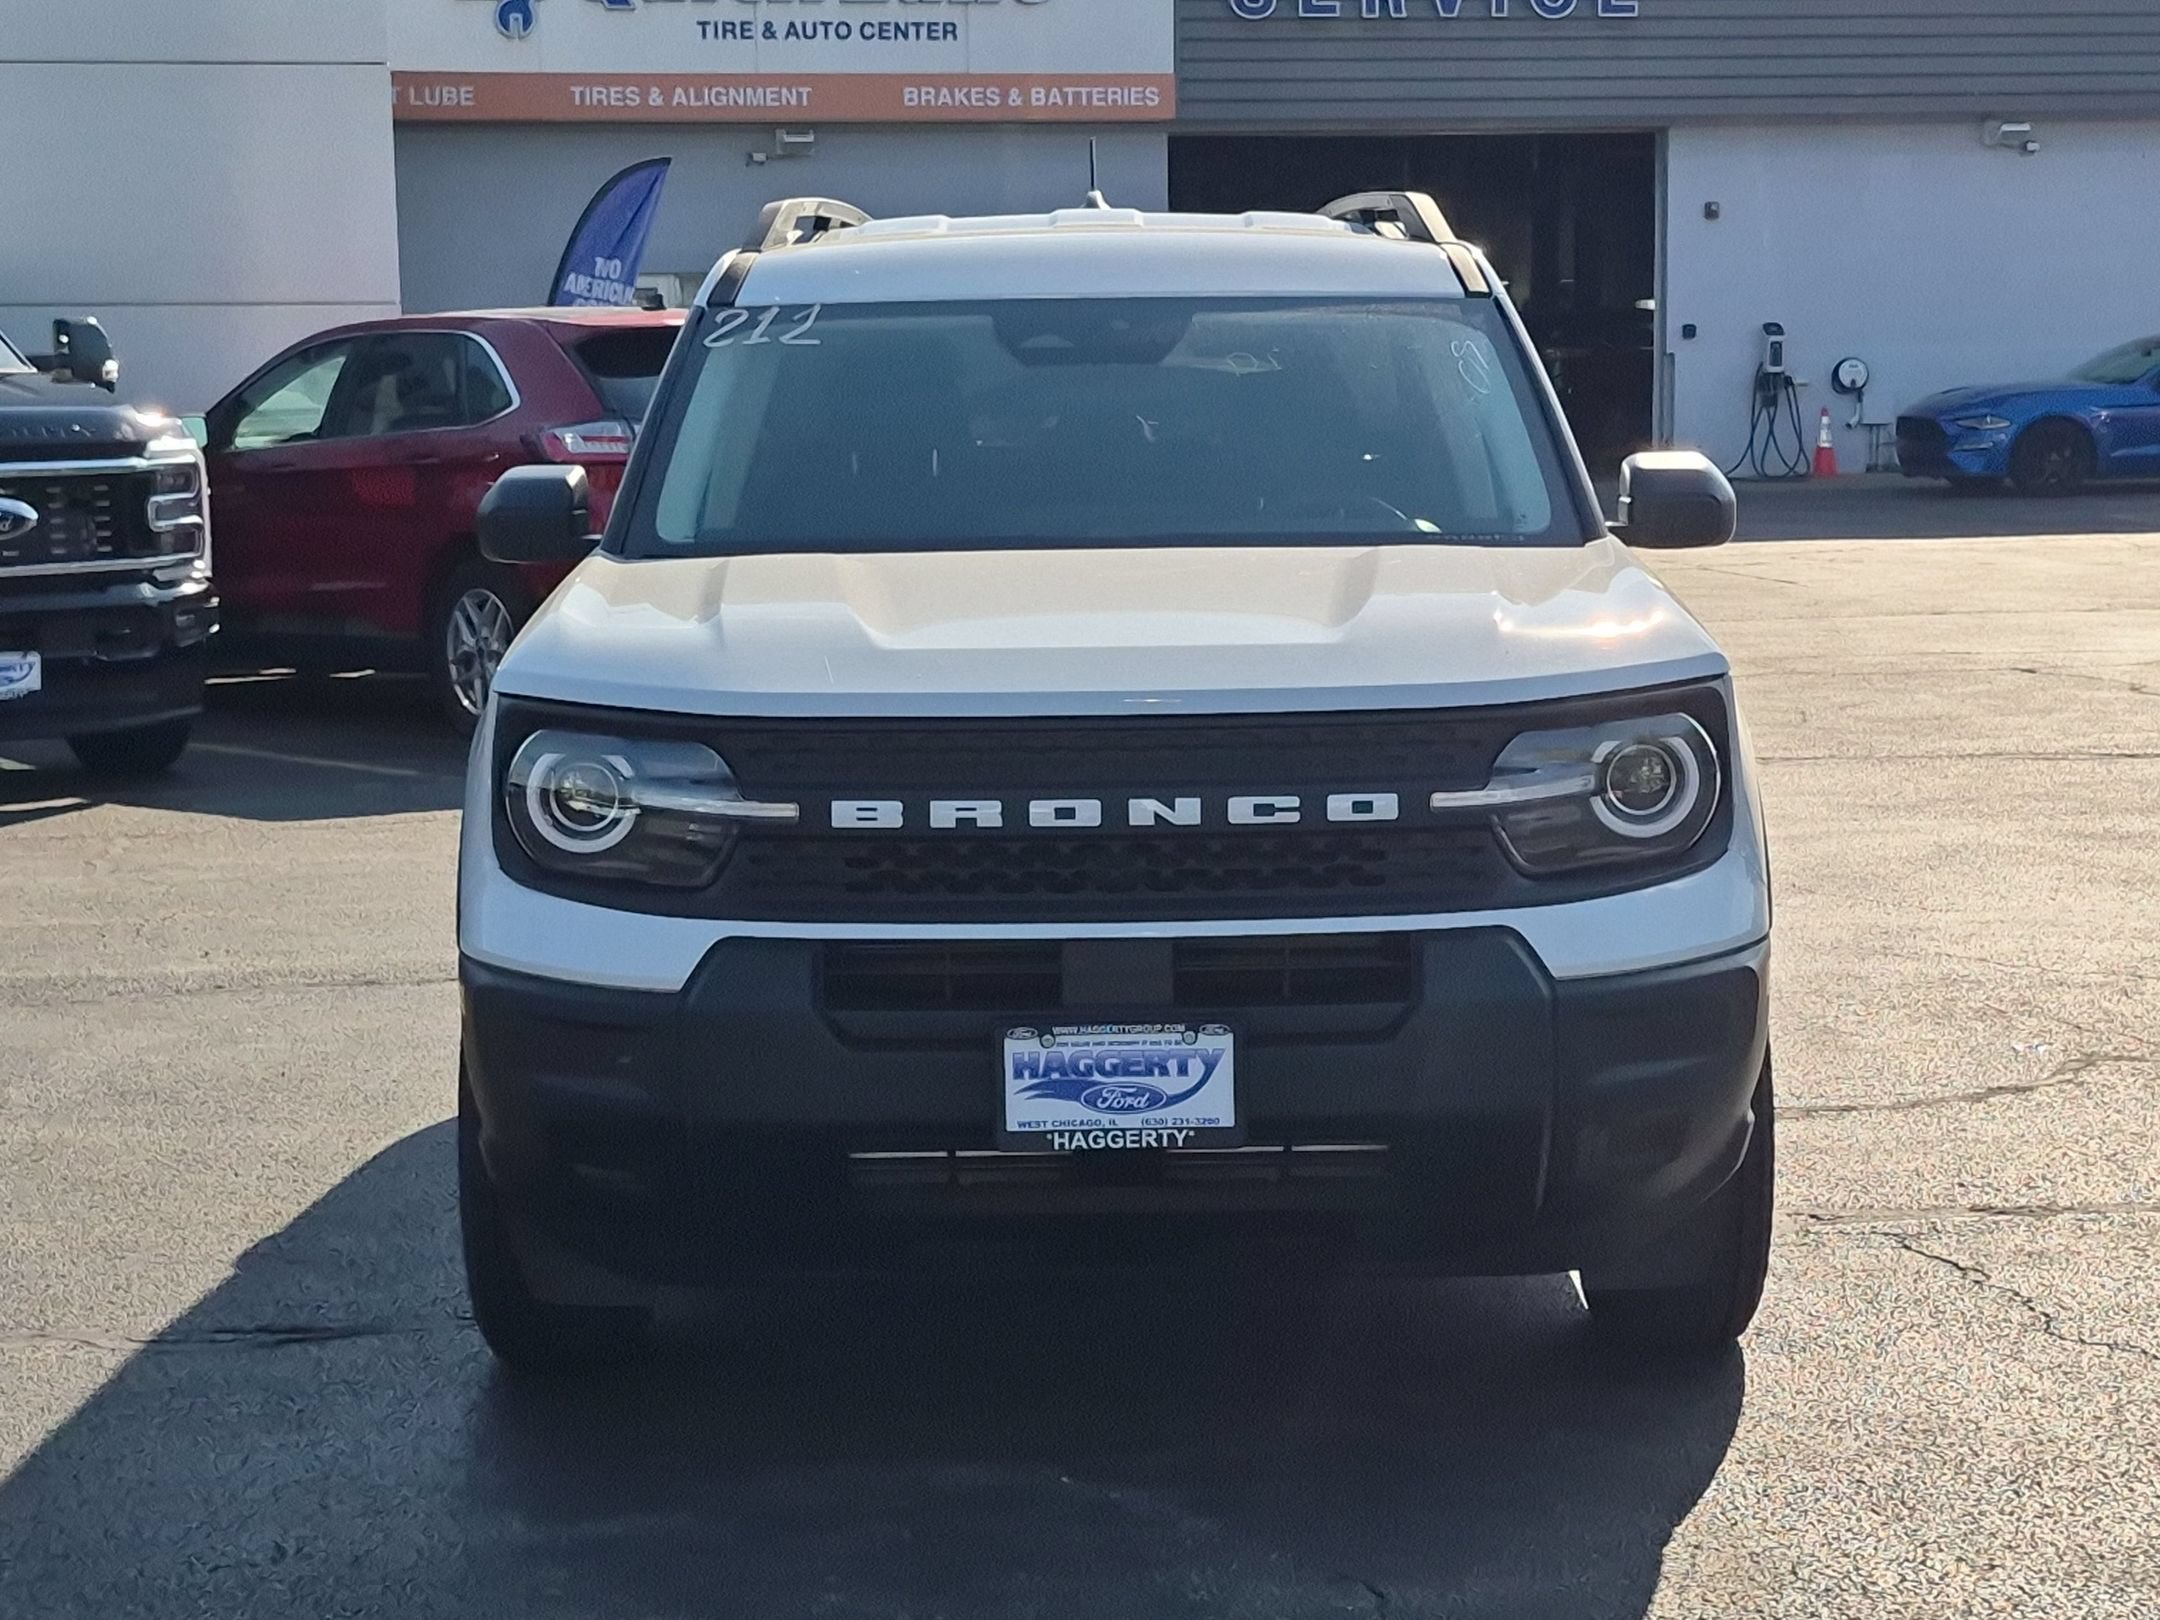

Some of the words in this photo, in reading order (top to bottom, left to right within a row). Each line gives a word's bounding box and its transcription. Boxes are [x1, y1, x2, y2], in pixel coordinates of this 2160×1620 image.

[696, 21, 754, 40] TIRE
[762, 20, 777, 40] &
[785, 21, 852, 40] AUTO
[859, 21, 958, 41] CENTER
[409, 86, 475, 106] LUBE
[570, 86, 641, 107] TIRES
[648, 86, 664, 106] &
[672, 87, 812, 107] ALIGNMENT
[903, 87, 1001, 107] BRAKES
[1008, 88, 1023, 106] &
[1031, 87, 1160, 107] BATTERIES
[831, 793, 1399, 829] BRONCO
[1012, 1048, 1226, 1080] HAGGERTY
[1096, 1086, 1150, 1109] Ford
[1017, 1120, 1048, 1129] WEST
[1109, 1118, 1119, 1127] IL
